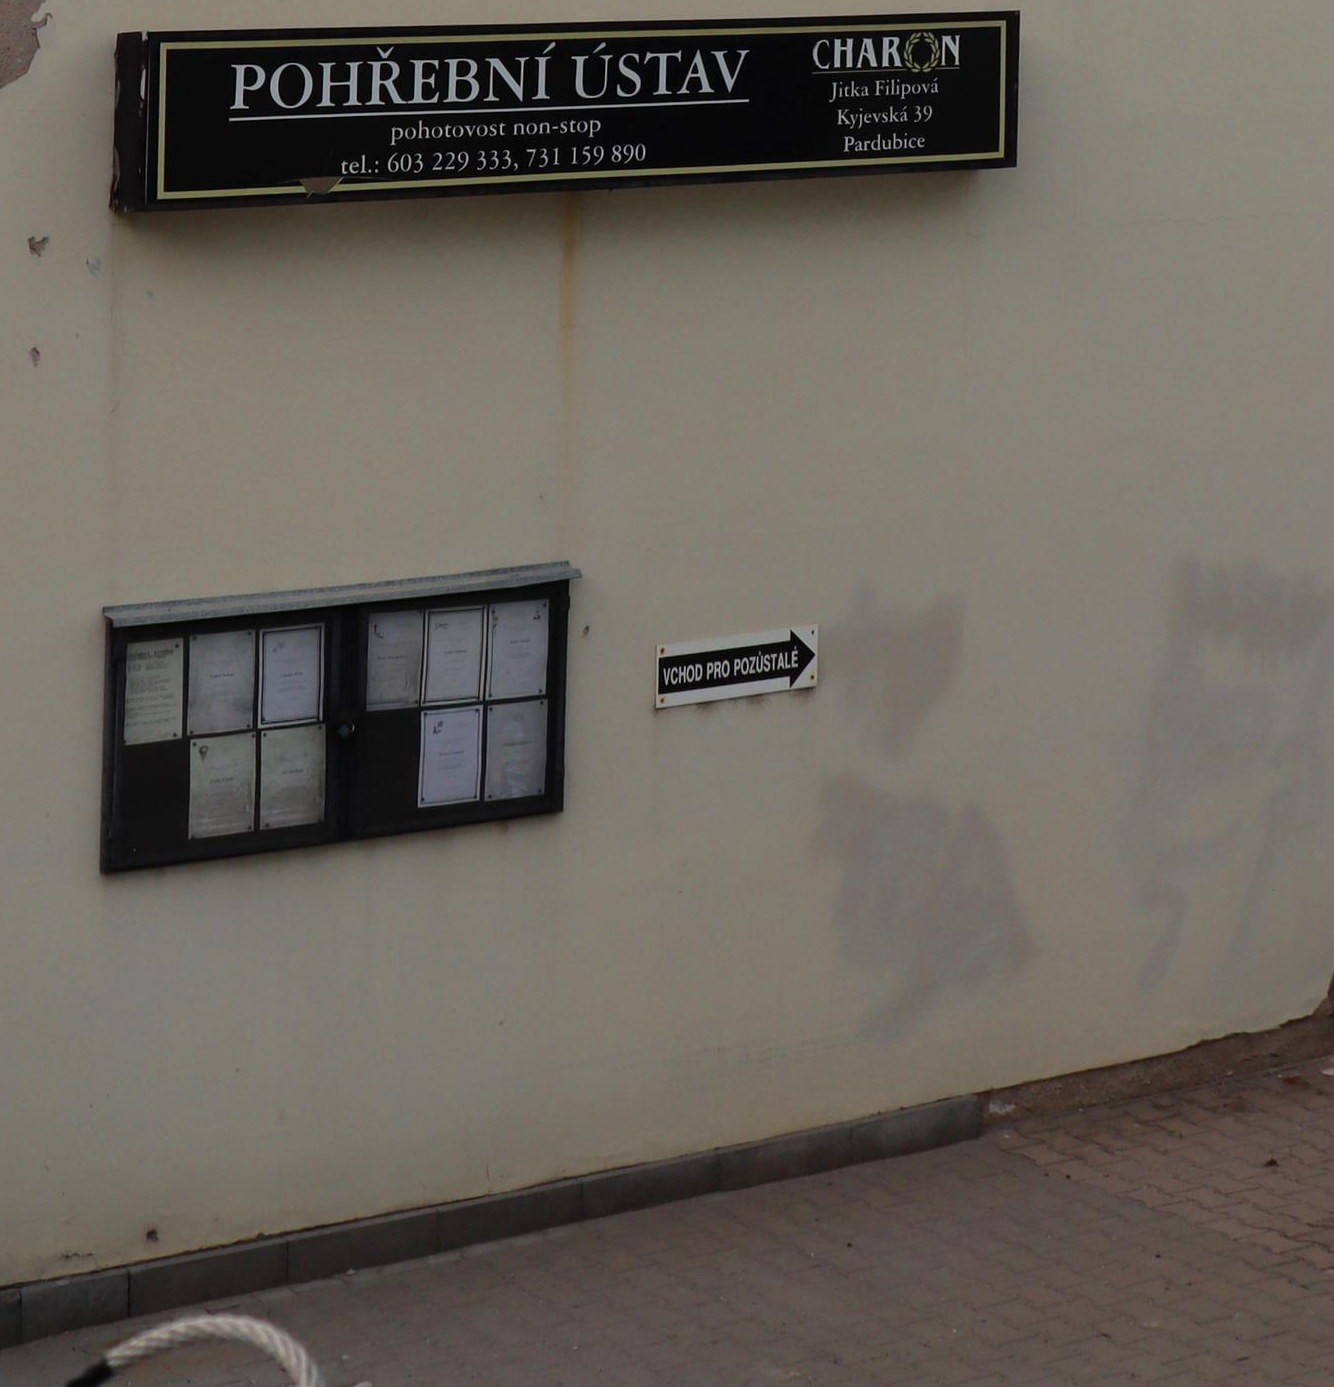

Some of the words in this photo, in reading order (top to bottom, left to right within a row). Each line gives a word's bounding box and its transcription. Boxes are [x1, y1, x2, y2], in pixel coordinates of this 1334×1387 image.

[812, 31, 960, 73] CHARON
[229, 42, 556, 110] POHŘEBNÍ
[571, 42, 750, 99] ÚSTAV
[829, 81, 869, 103] Jitka
[875, 77, 939, 99] Filipová
[837, 106, 908, 129] Kyjevská
[914, 105, 933, 122] 39
[390, 120, 505, 145] pohotovost
[513, 119, 601, 137] non-stop
[843, 133, 925, 152] Pardubice
[341, 155, 379, 175] tel.:
[387, 152, 424, 173] 603
[432, 151, 469, 171] 229
[477, 149, 519, 172] 333,
[527, 148, 560, 168] 731
[571, 146, 604, 166] 159
[611, 143, 646, 164] 890
[663, 663, 703, 686] VCHOD
[706, 660, 730, 680] PRO
